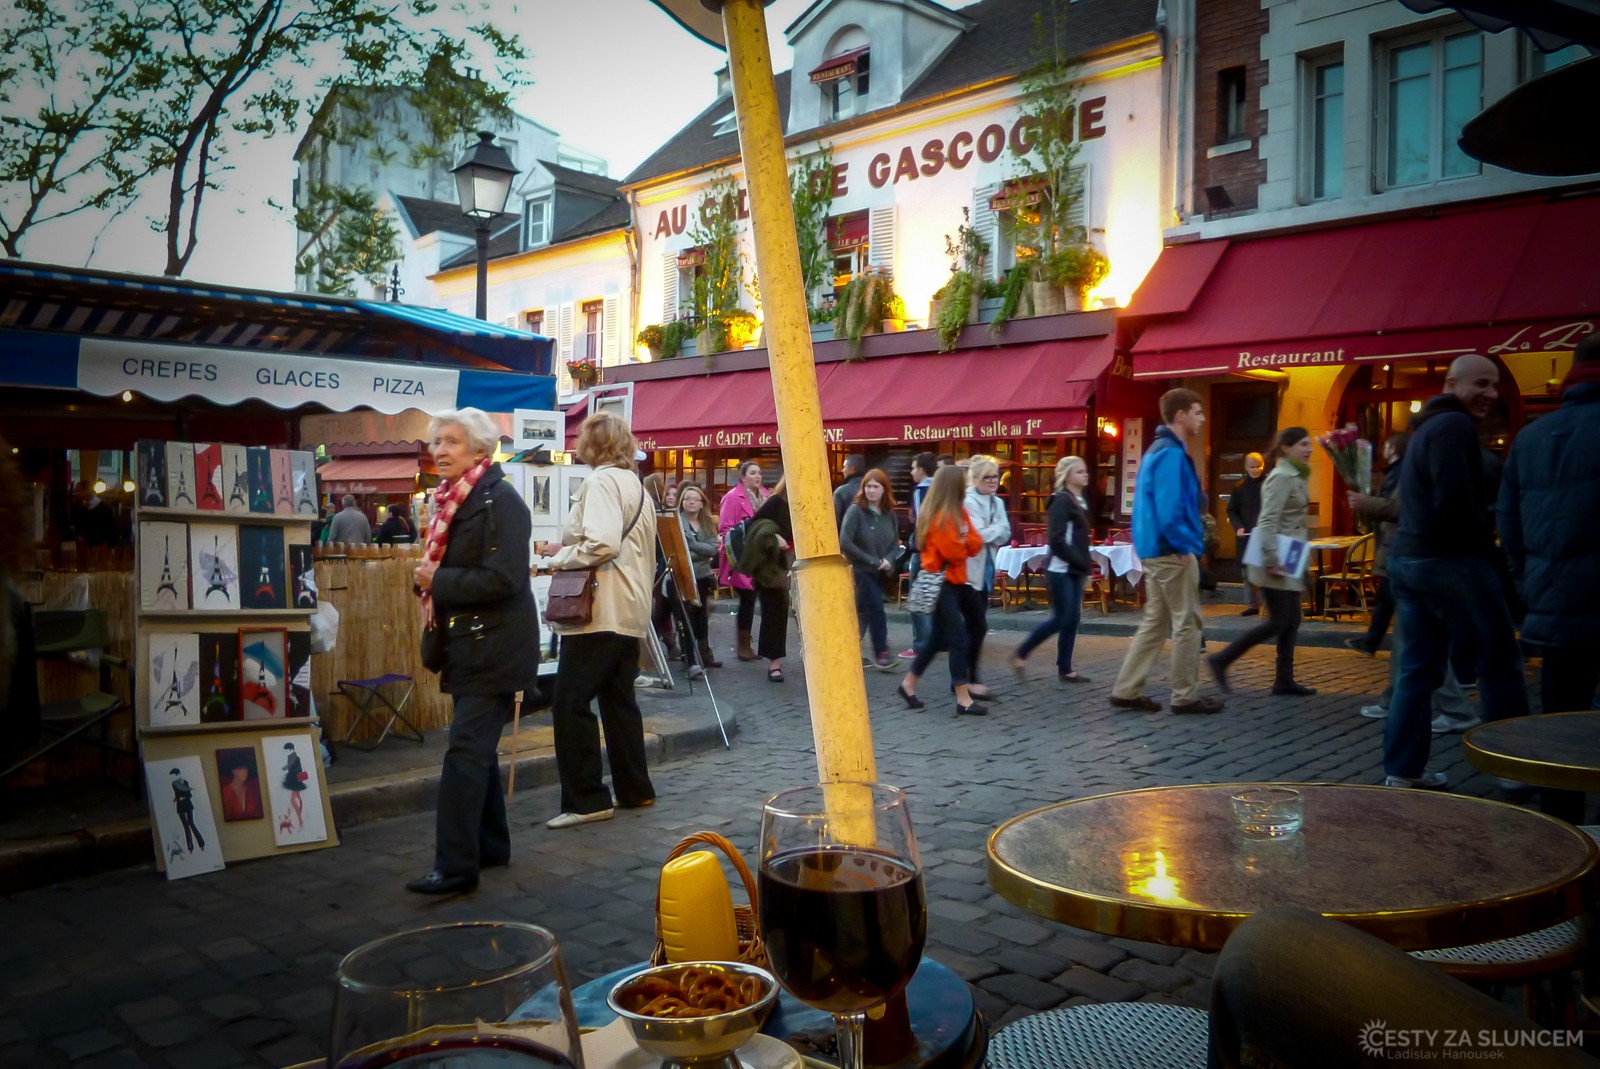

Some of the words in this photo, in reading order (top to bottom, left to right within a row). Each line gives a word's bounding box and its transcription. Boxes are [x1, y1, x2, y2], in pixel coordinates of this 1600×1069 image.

[654, 204, 687, 241] AU
[1236, 348, 1345, 369] Restaurant
[1487, 325, 1533, 354] La
[122, 357, 218, 382] CREPES
[255, 367, 341, 390] GLACES
[373, 376, 426, 397] PIZZA
[697, 434, 713, 448] AU
[715, 430, 754, 446] CADET
[758, 432, 772, 445] de
[903, 422, 974, 440] Restaurant
[980, 420, 1008, 438] salle
[1010, 425, 1022, 436] au
[1025, 418, 1042, 436] 1er
